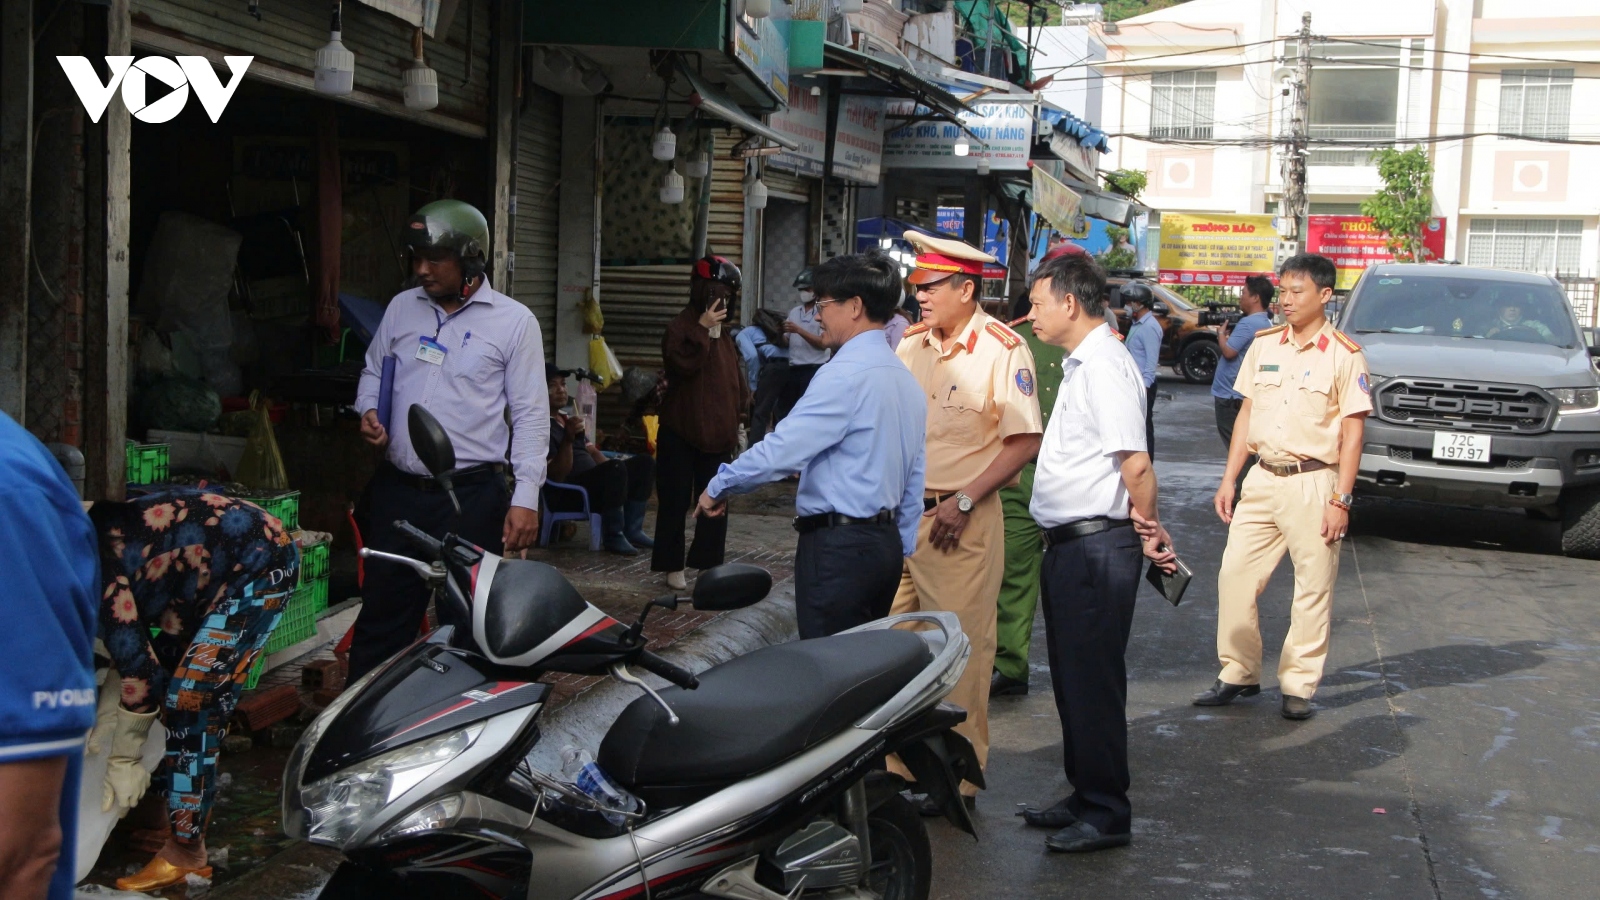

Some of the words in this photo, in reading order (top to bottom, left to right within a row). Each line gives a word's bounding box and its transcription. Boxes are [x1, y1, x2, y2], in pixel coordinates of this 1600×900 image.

[995, 122, 1025, 140] NẮNG
[1191, 222, 1230, 233] THÔNG
[1232, 223, 1256, 234] BÁO
[1393, 394, 1539, 418] FORD
[1450, 434, 1475, 447] 72C
[1440, 447, 1483, 460] 197.97
[269, 561, 295, 586] Dior
